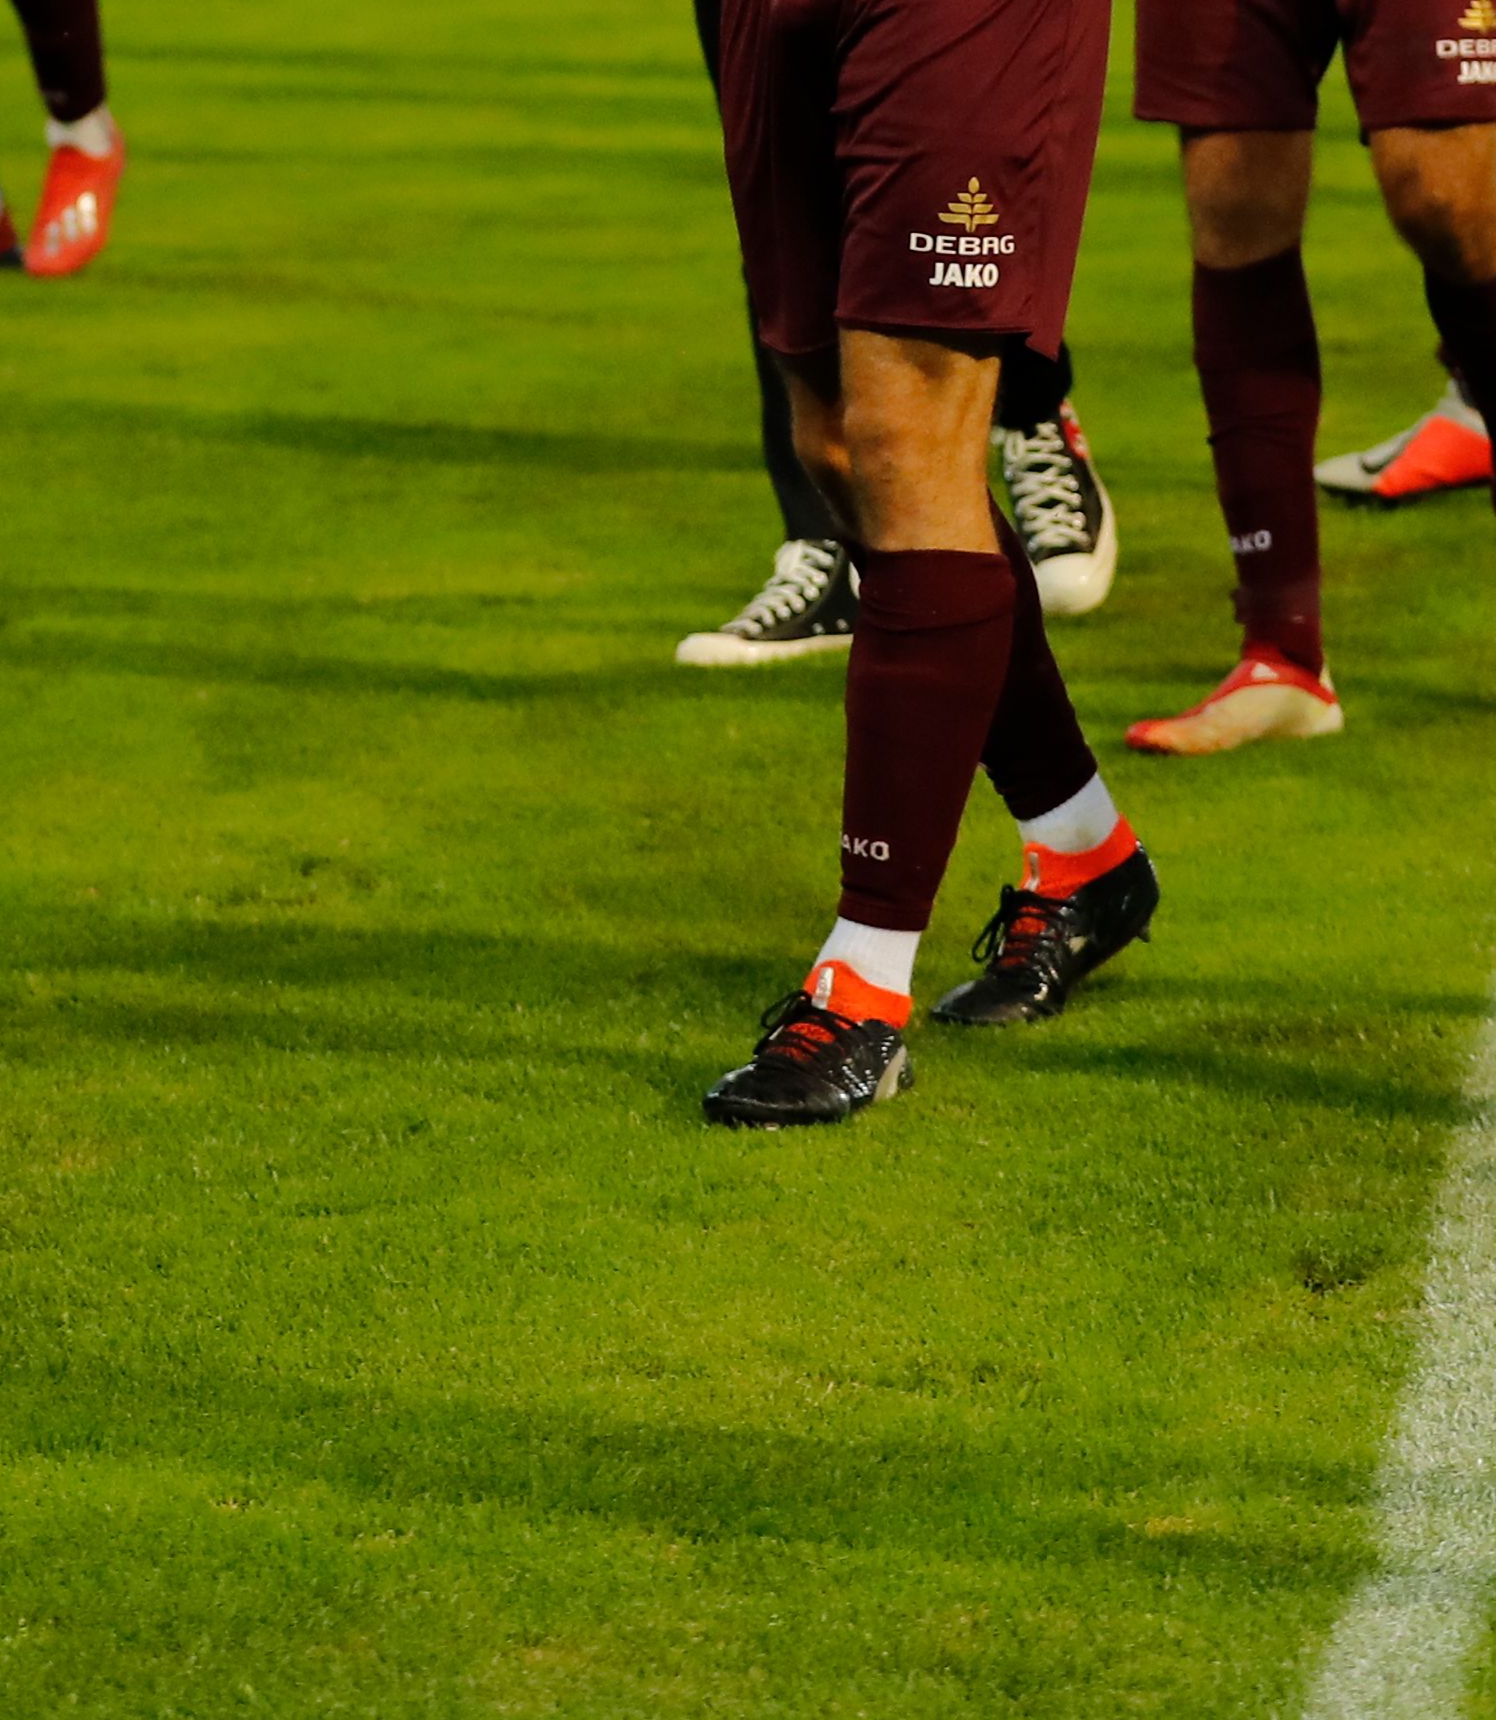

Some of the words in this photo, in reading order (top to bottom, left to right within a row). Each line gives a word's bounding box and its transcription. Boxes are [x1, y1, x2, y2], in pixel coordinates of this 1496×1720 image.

[909, 232, 1015, 256] DEBAG
[929, 262, 999, 288] JAKO
[1230, 529, 1273, 554] AKO
[840, 833, 890, 861] AKO
